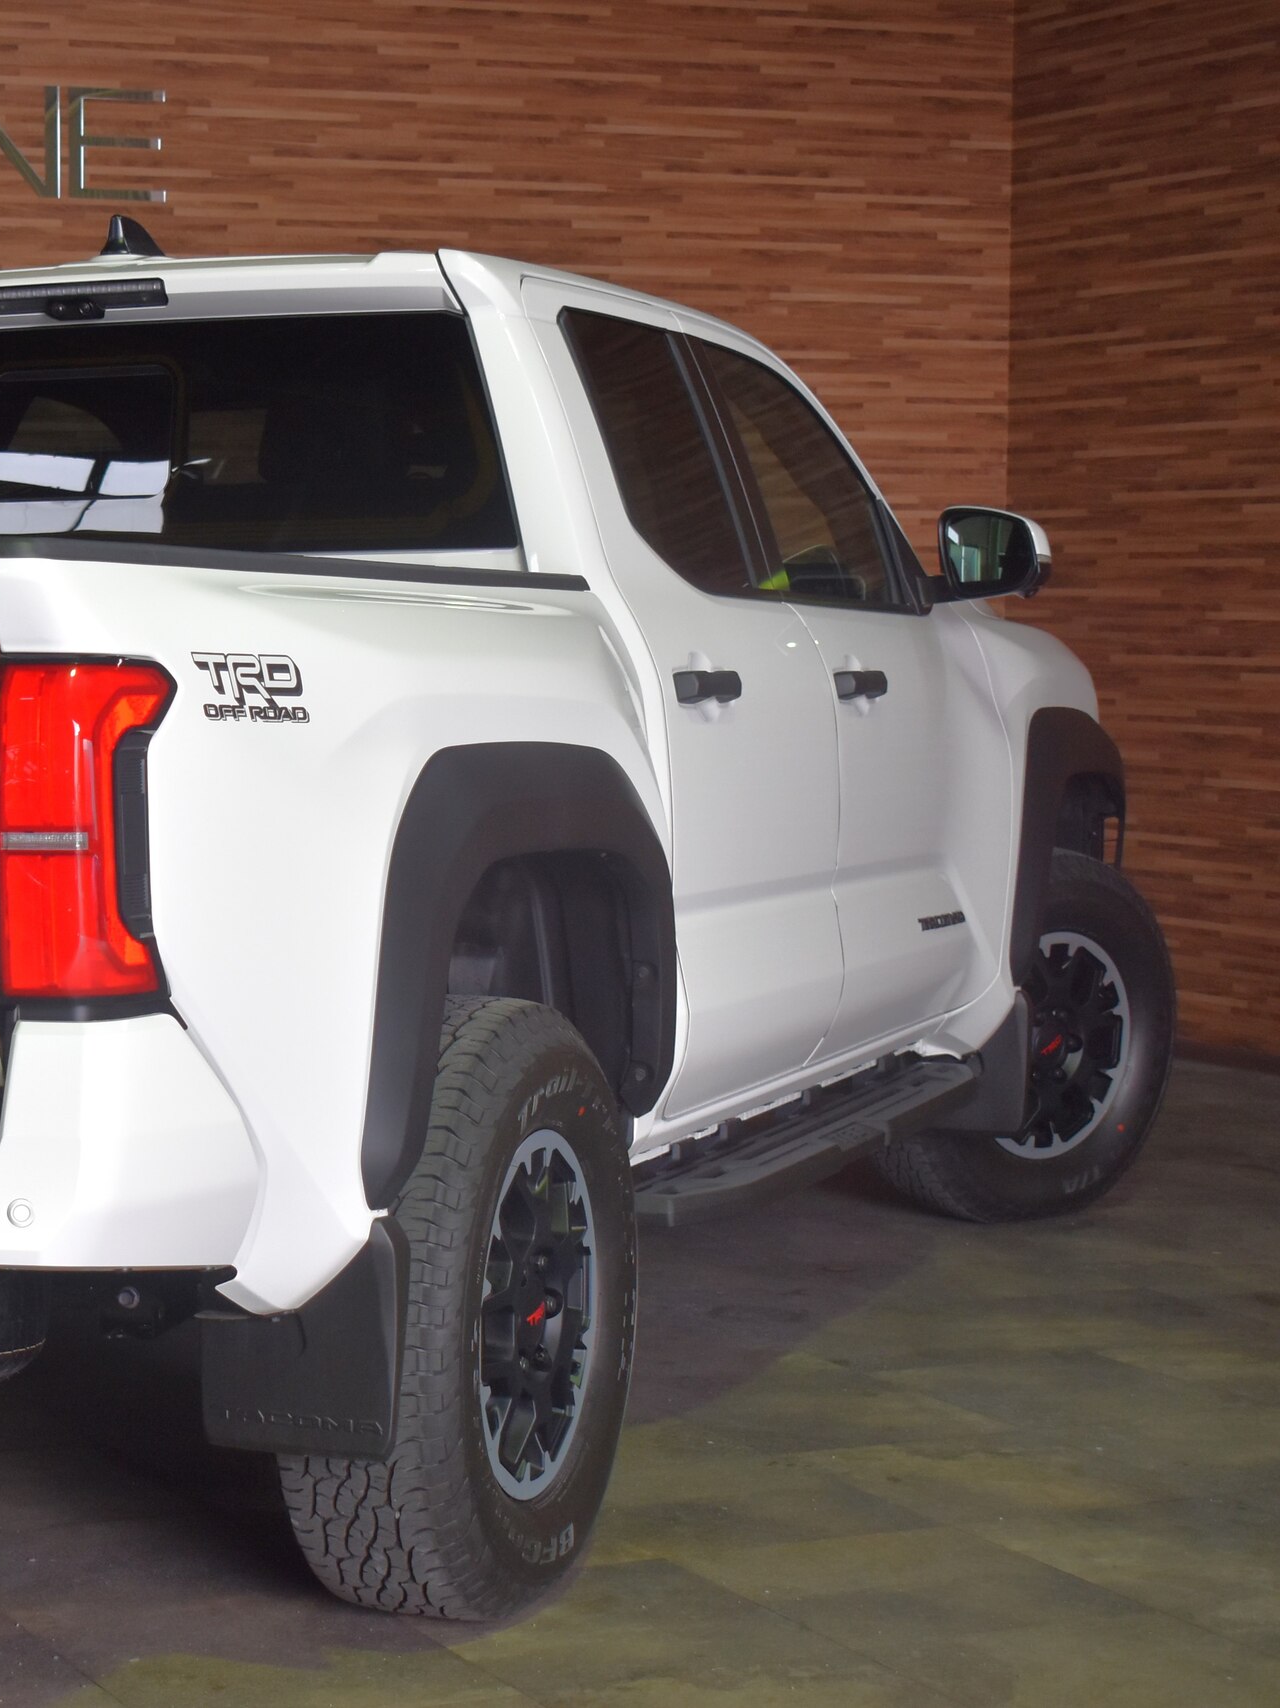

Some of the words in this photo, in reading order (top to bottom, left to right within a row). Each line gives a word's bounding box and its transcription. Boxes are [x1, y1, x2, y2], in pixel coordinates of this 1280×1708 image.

[191, 652, 303, 707] TRD
[203, 703, 247, 722] OFF
[247, 705, 310, 723] ROAD
